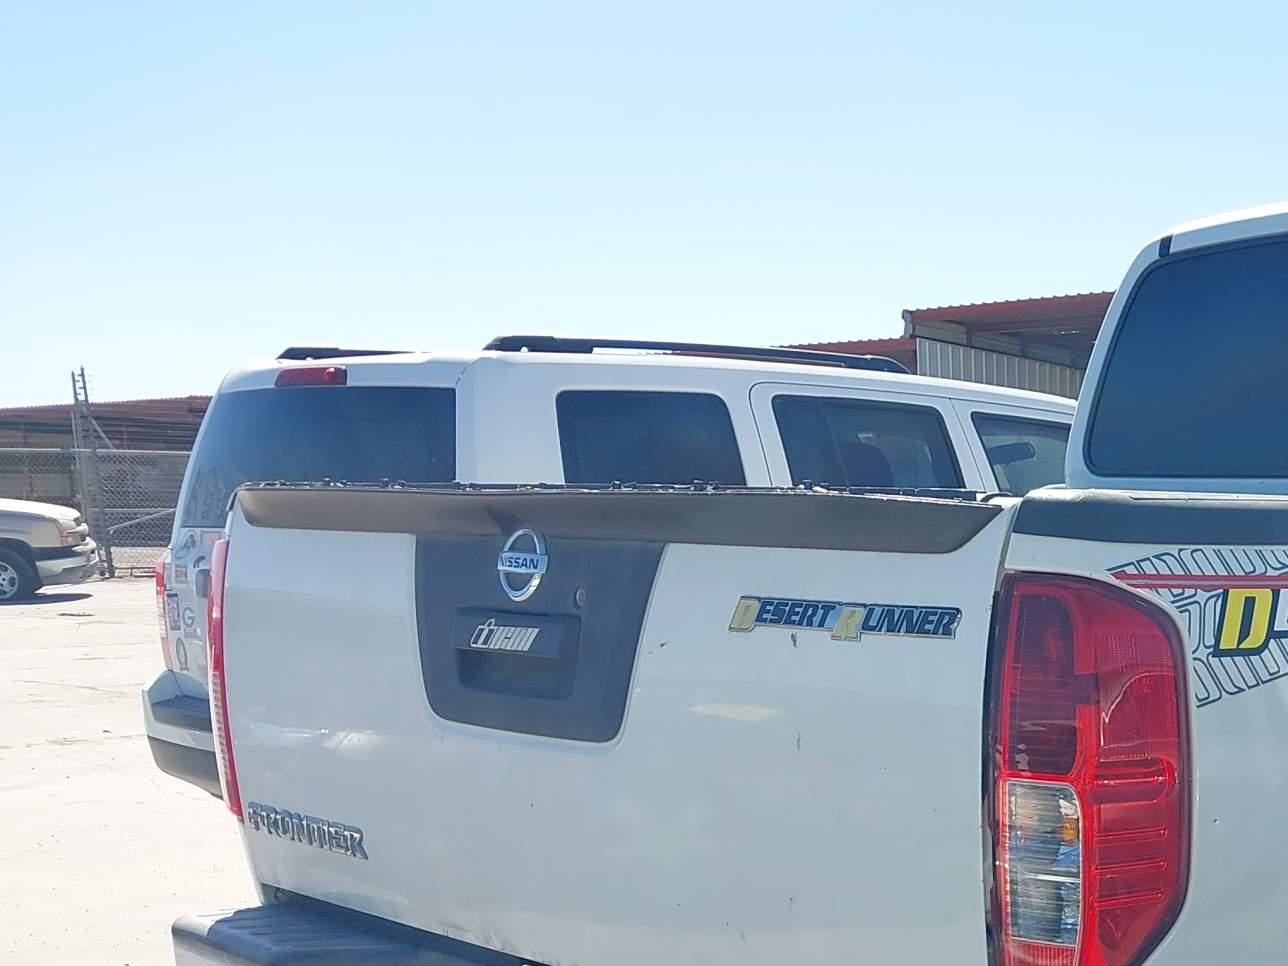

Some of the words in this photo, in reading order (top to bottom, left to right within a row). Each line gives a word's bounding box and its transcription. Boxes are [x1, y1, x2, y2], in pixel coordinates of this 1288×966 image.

[499, 556, 540, 570] NISSAN
[729, 597, 838, 632] DESERT
[831, 603, 961, 641] RUNNER
[247, 801, 369, 860] FRONTIER
